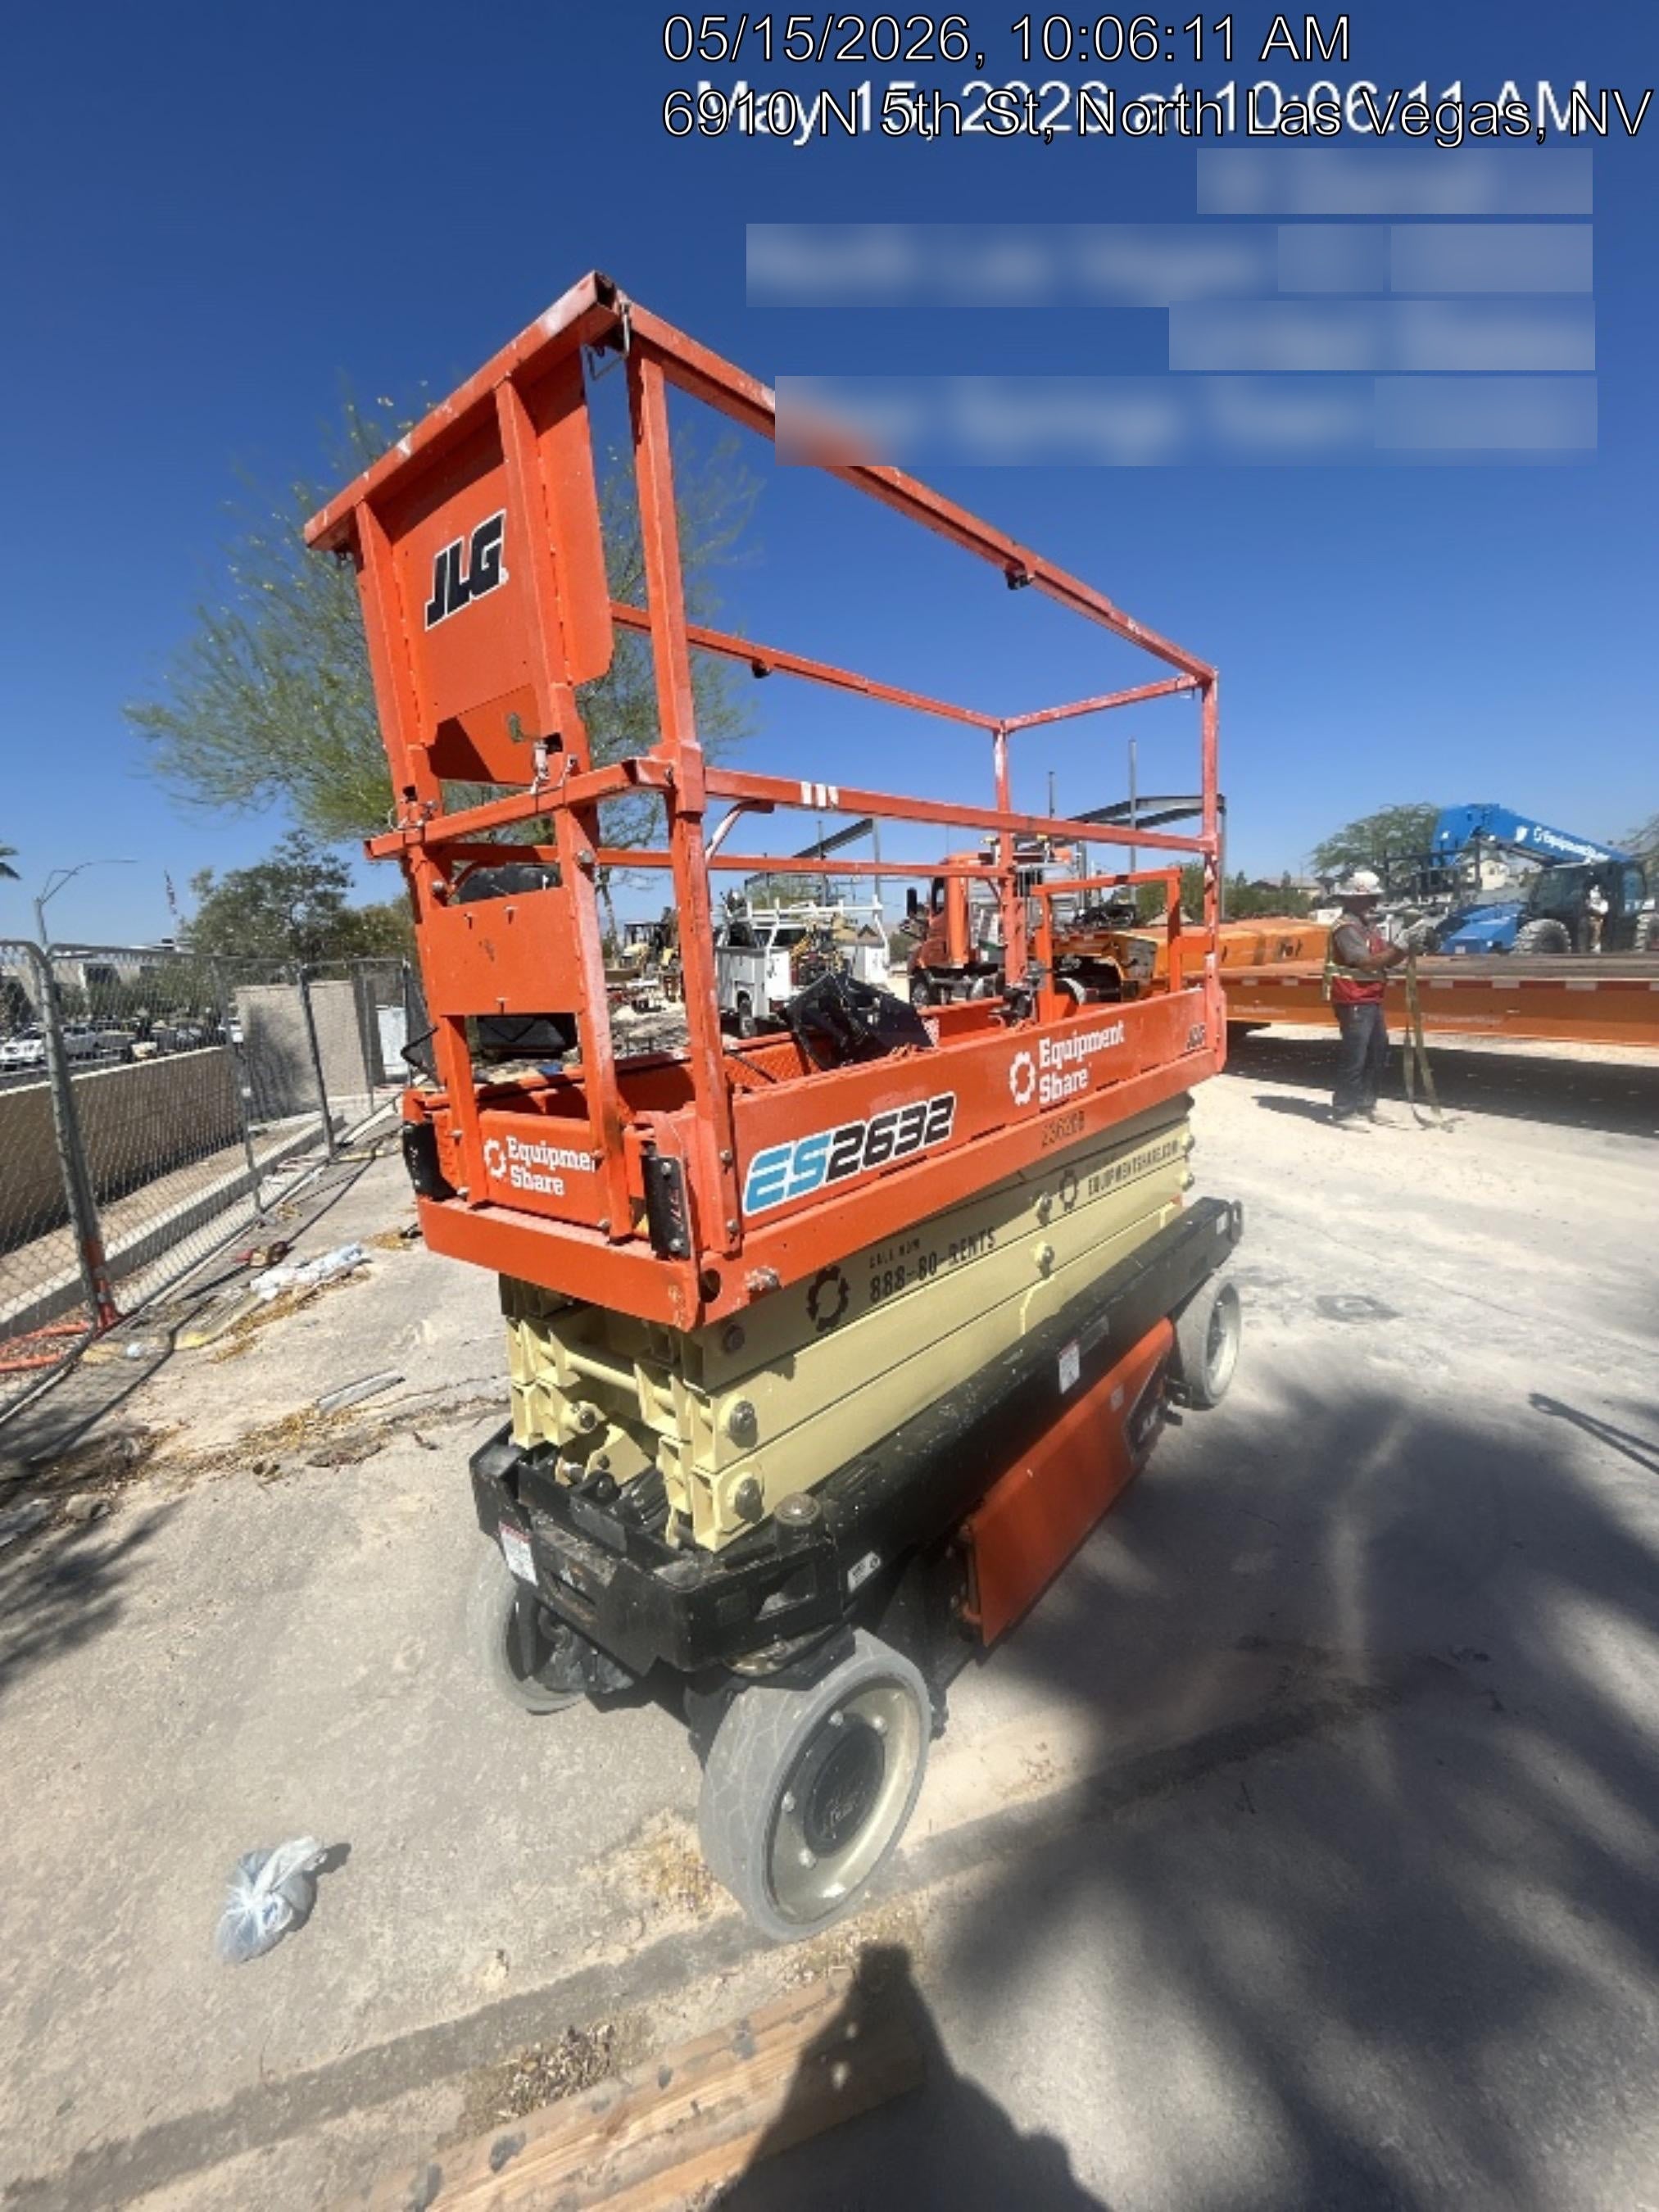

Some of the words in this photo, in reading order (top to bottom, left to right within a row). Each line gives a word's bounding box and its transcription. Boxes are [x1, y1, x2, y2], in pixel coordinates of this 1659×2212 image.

[424, 508, 508, 632] JLG
[1039, 1019, 1125, 1069] Equipment
[1039, 1067, 1090, 1104] Share
[505, 1135, 596, 1172] Equipme
[742, 1090, 956, 1215] ES2632
[510, 1164, 565, 1196] Share
